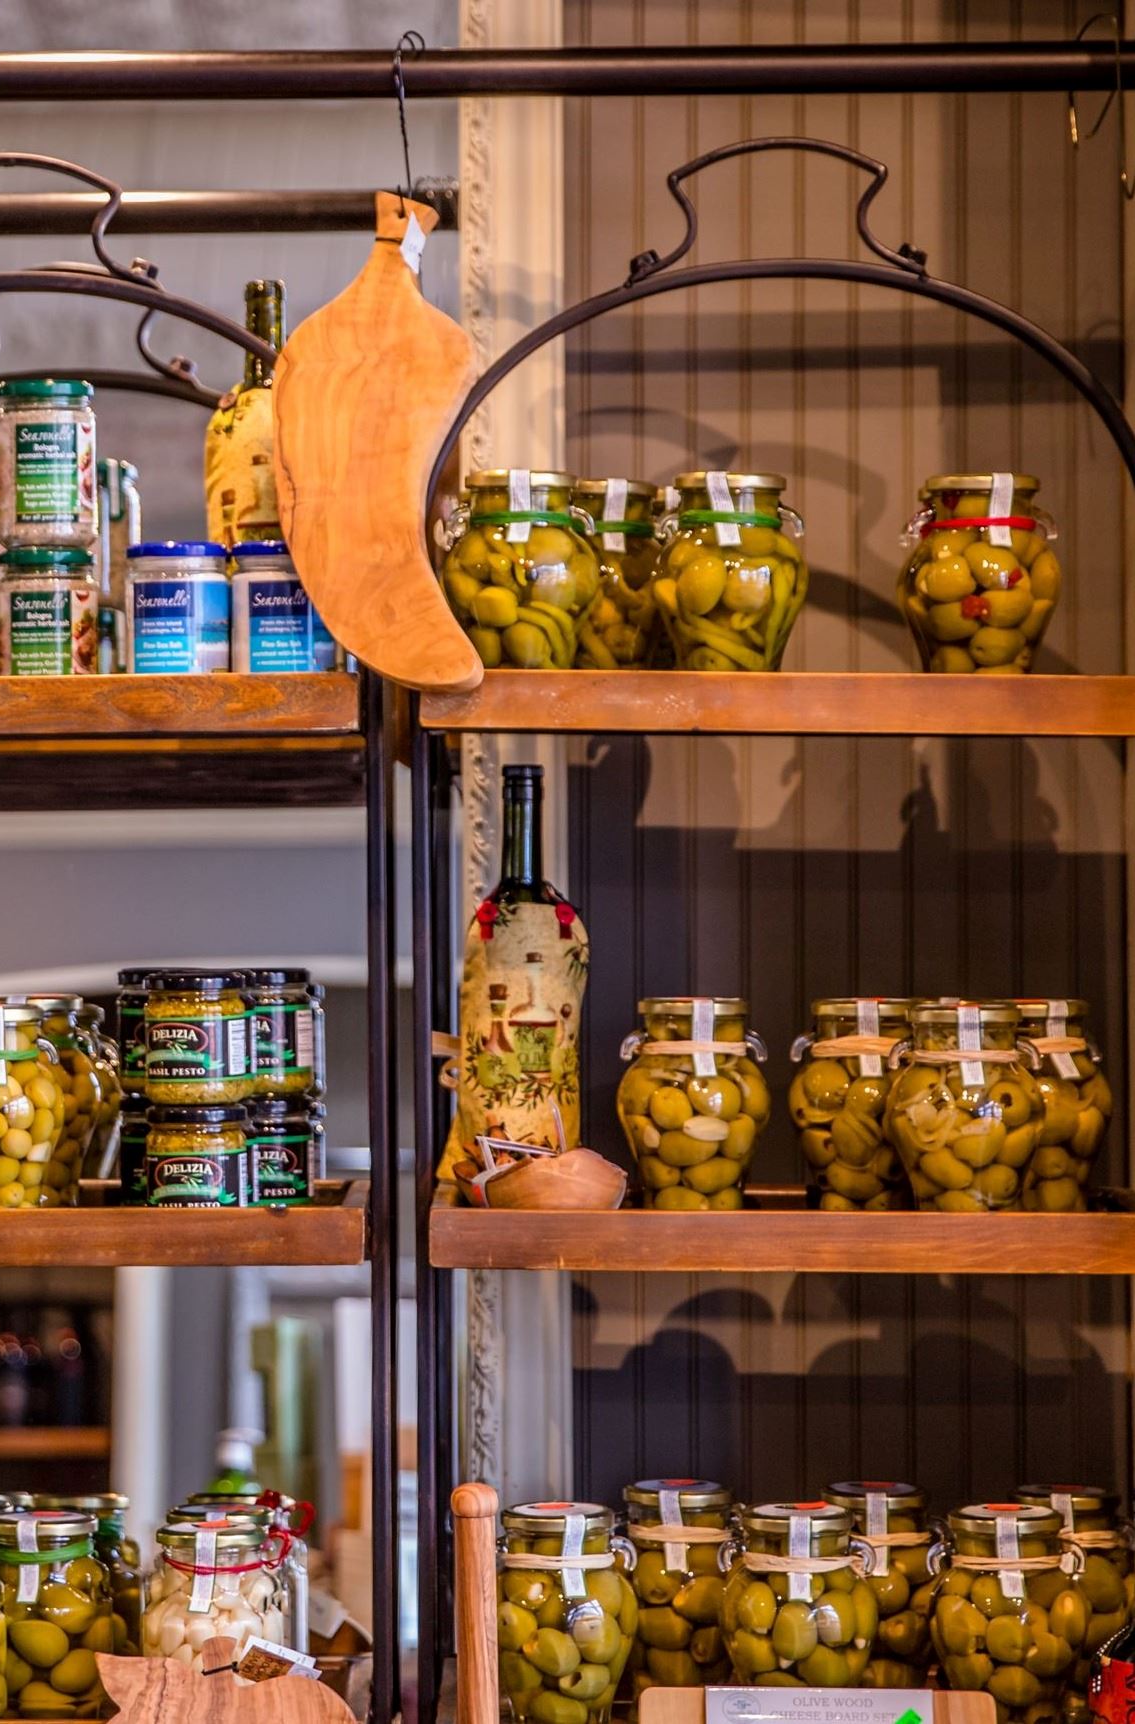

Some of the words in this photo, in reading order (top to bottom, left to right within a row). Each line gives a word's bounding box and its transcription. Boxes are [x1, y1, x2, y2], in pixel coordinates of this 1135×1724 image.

[33, 443, 60, 453] Bologna
[45, 451, 65, 459] herbal
[27, 612, 53, 621] Bologna
[152, 1029, 198, 1041] DELIZIA
[172, 1067, 206, 1076] PESTO
[164, 1163, 214, 1176] DELIZIA
[264, 1188, 297, 1197] PESTO
[792, 1697, 830, 1708] OLIVE
[833, 1697, 874, 1708] WOOD
[825, 1711, 869, 1722] BOARD
